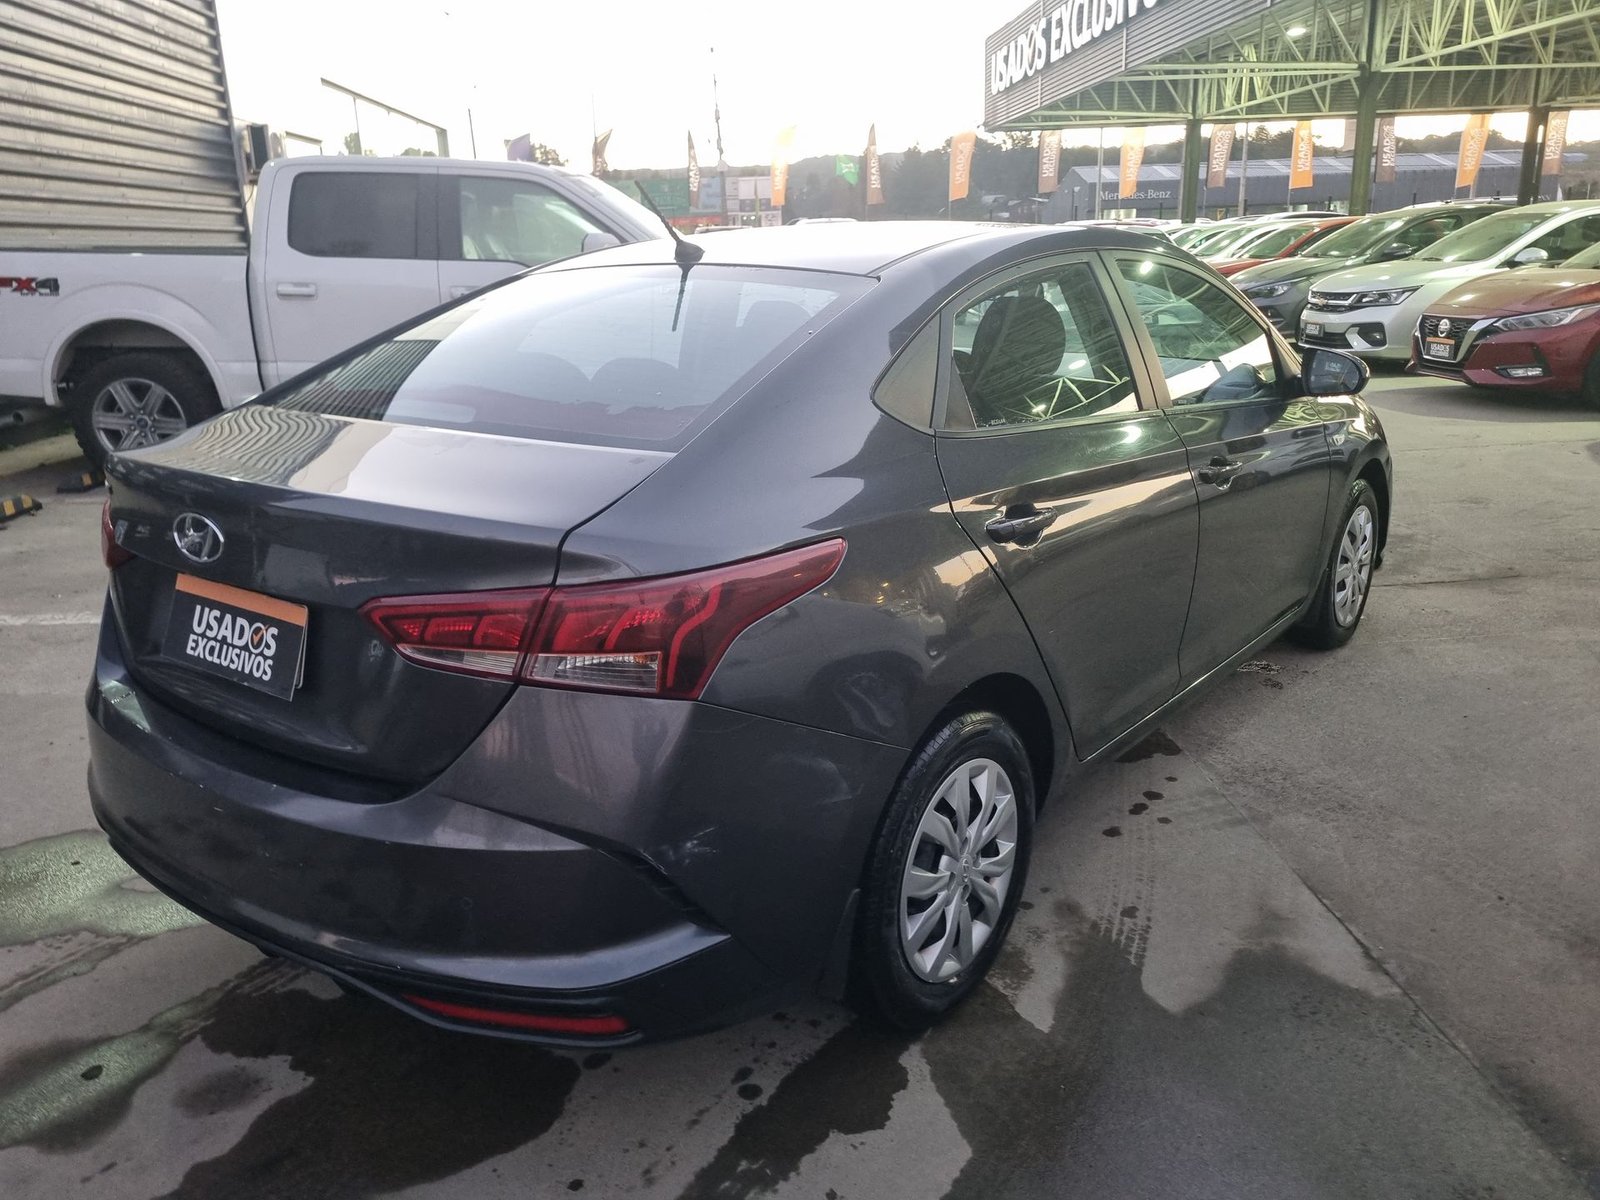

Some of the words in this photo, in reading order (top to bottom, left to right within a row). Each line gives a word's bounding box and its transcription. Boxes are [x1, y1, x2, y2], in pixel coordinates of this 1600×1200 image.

[991, 18, 1047, 95] USADOS
[1212, 130, 1225, 171] USADOS
[1382, 125, 1391, 167] USADOS
[1100, 189, 1171, 200] Meres-Benz
[193, 604, 279, 658] USADOS
[186, 633, 274, 682] EXCLUSIVOS
